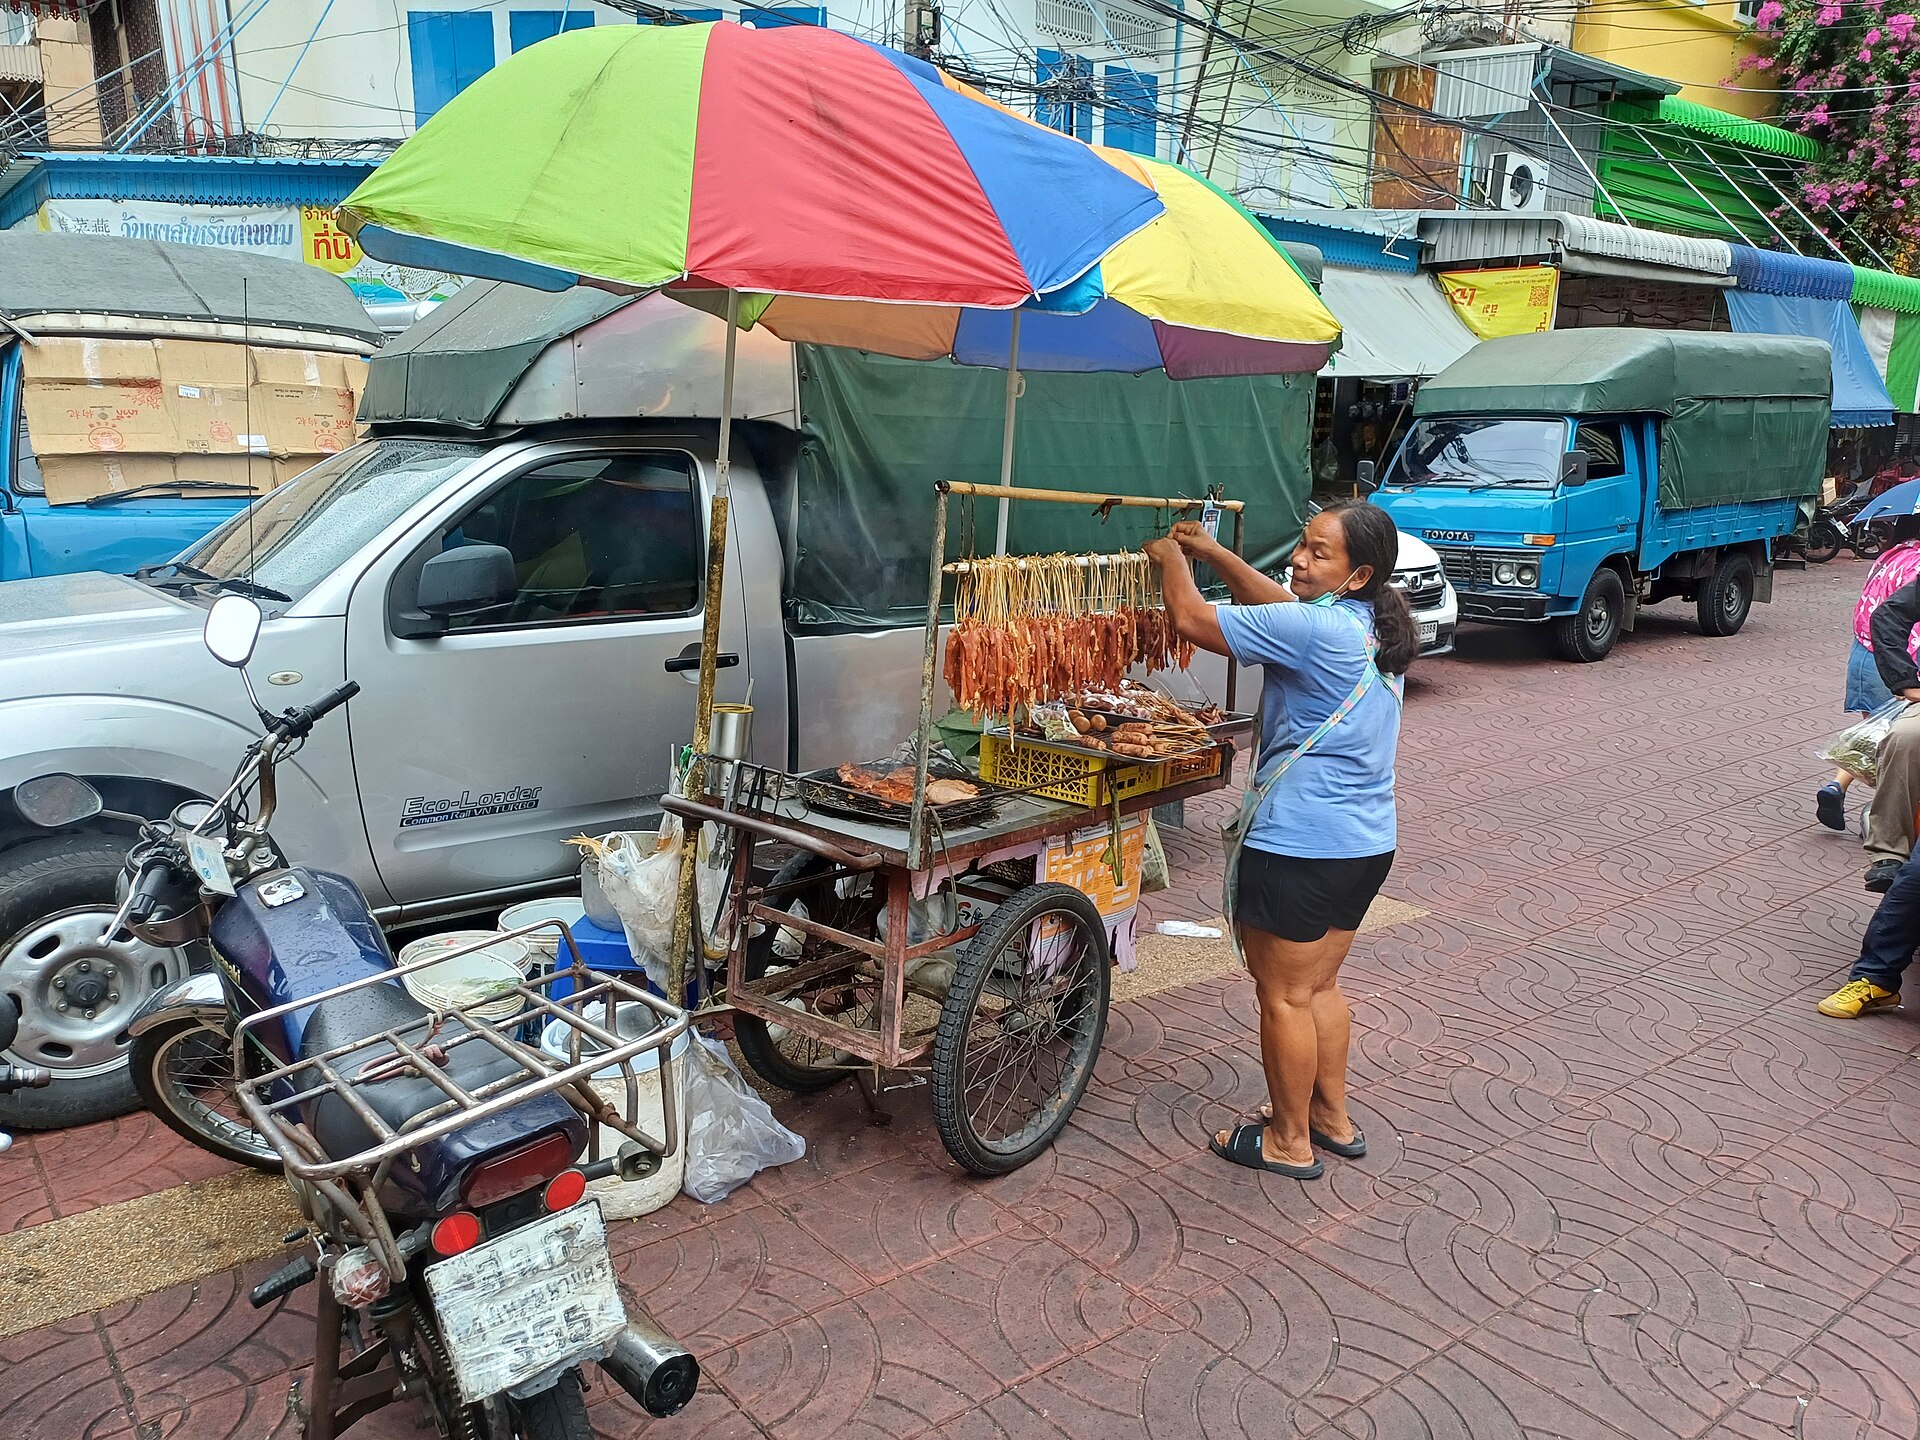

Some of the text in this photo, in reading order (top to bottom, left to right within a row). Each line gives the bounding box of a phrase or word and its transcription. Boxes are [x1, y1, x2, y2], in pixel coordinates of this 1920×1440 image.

[1424, 529, 1469, 541] TOYOTA
[401, 785, 542, 817] Eco-Loader
[402, 800, 536, 827] Common Rail VN TURBO
